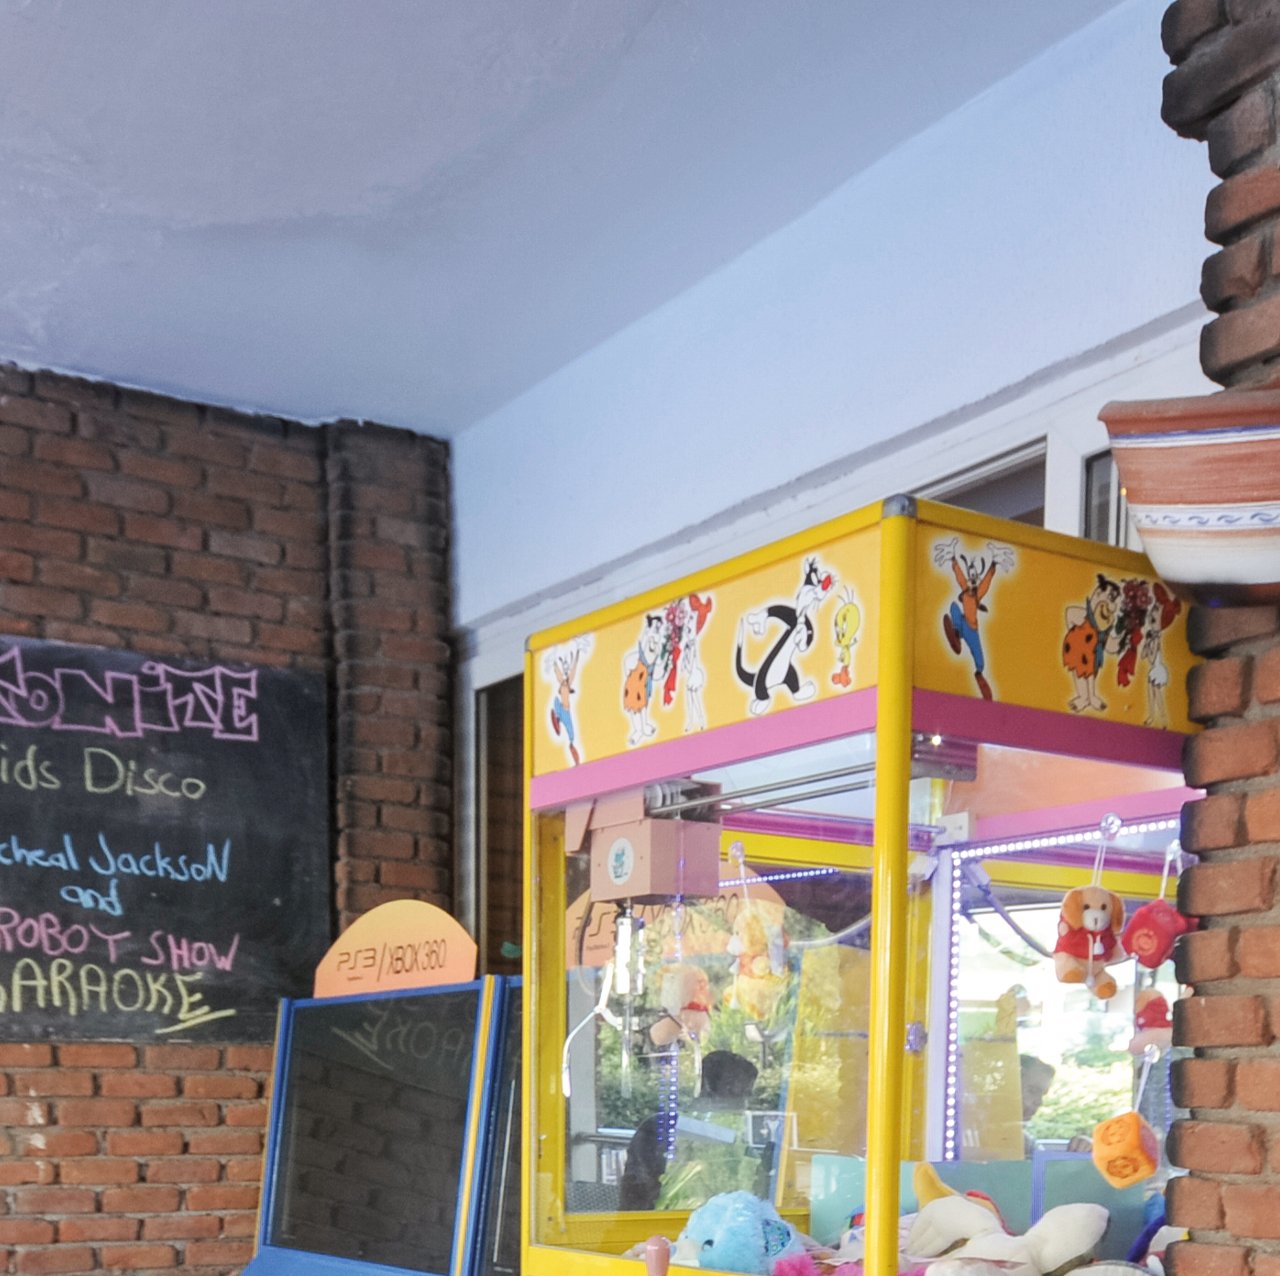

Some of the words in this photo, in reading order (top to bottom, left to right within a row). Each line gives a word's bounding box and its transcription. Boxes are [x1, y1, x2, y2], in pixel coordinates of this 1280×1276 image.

[84, 746, 207, 799] Disco
[60, 878, 124, 916] and
[141, 930, 239, 971] SHOW
